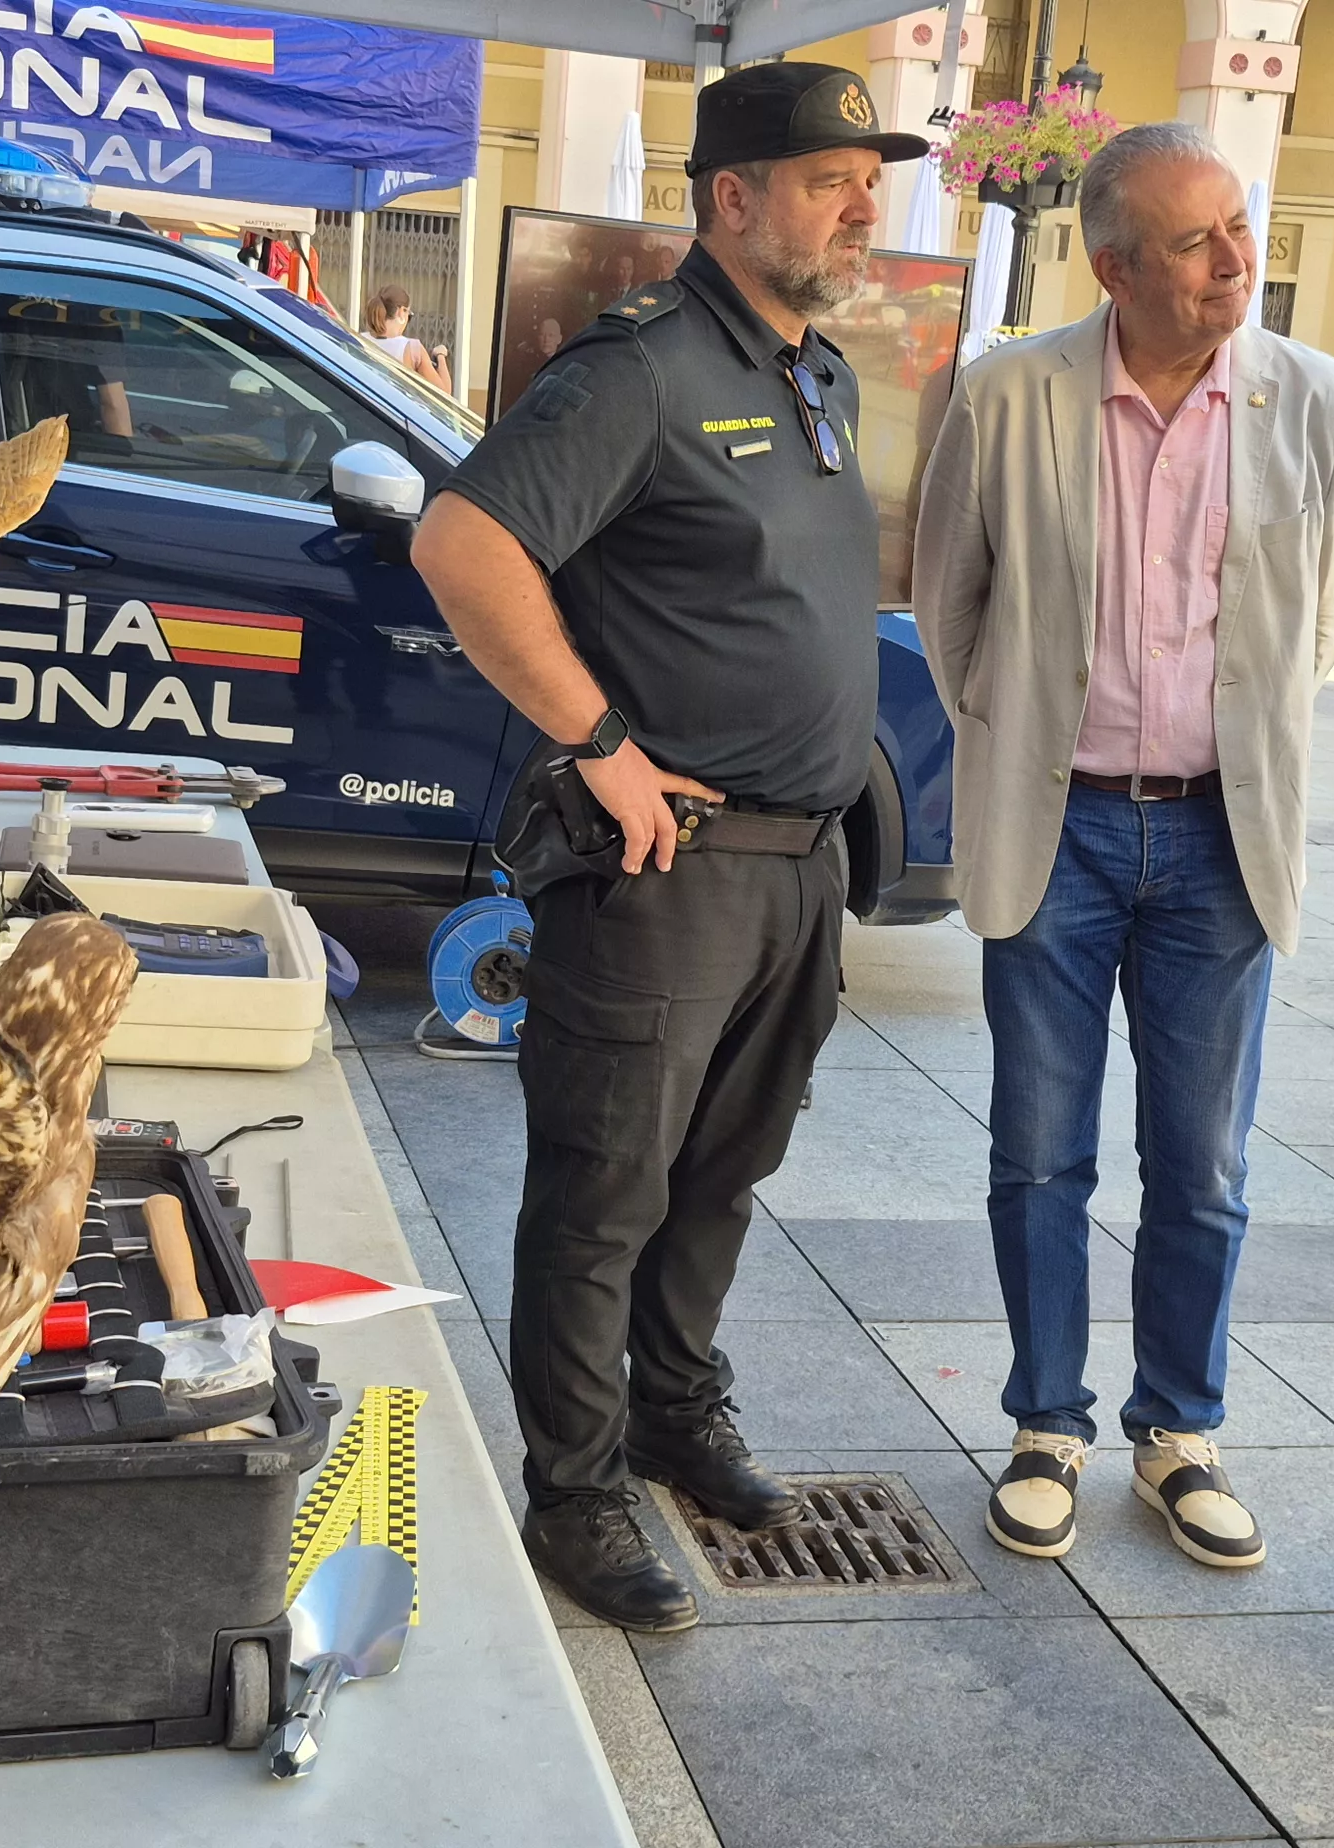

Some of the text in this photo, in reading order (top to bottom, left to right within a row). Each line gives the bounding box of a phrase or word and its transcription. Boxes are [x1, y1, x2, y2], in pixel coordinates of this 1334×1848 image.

[702, 417, 776, 432] GUARDIA CIVIL
[339, 773, 455, 807] @policia
